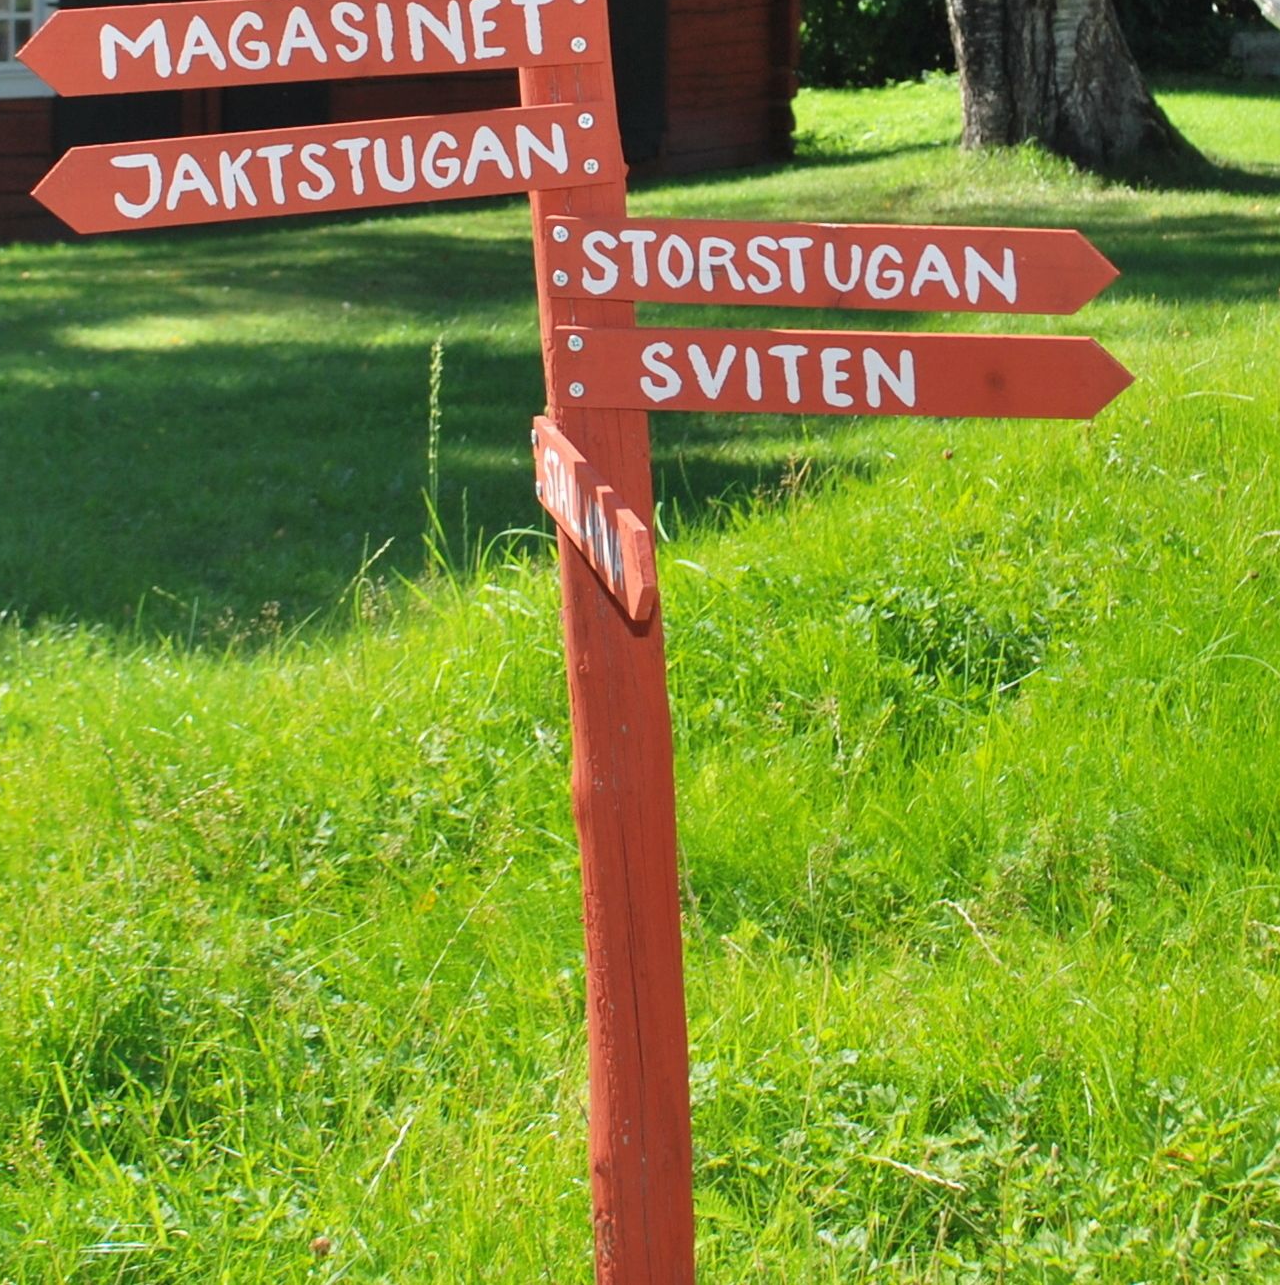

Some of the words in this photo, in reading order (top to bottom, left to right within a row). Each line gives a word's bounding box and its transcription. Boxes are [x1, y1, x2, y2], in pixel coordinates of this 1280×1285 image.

[110, 122, 570, 220] JAKTSTUGAN
[581, 228, 1019, 305] STORSTUGAN
[639, 341, 917, 409] SVITEN
